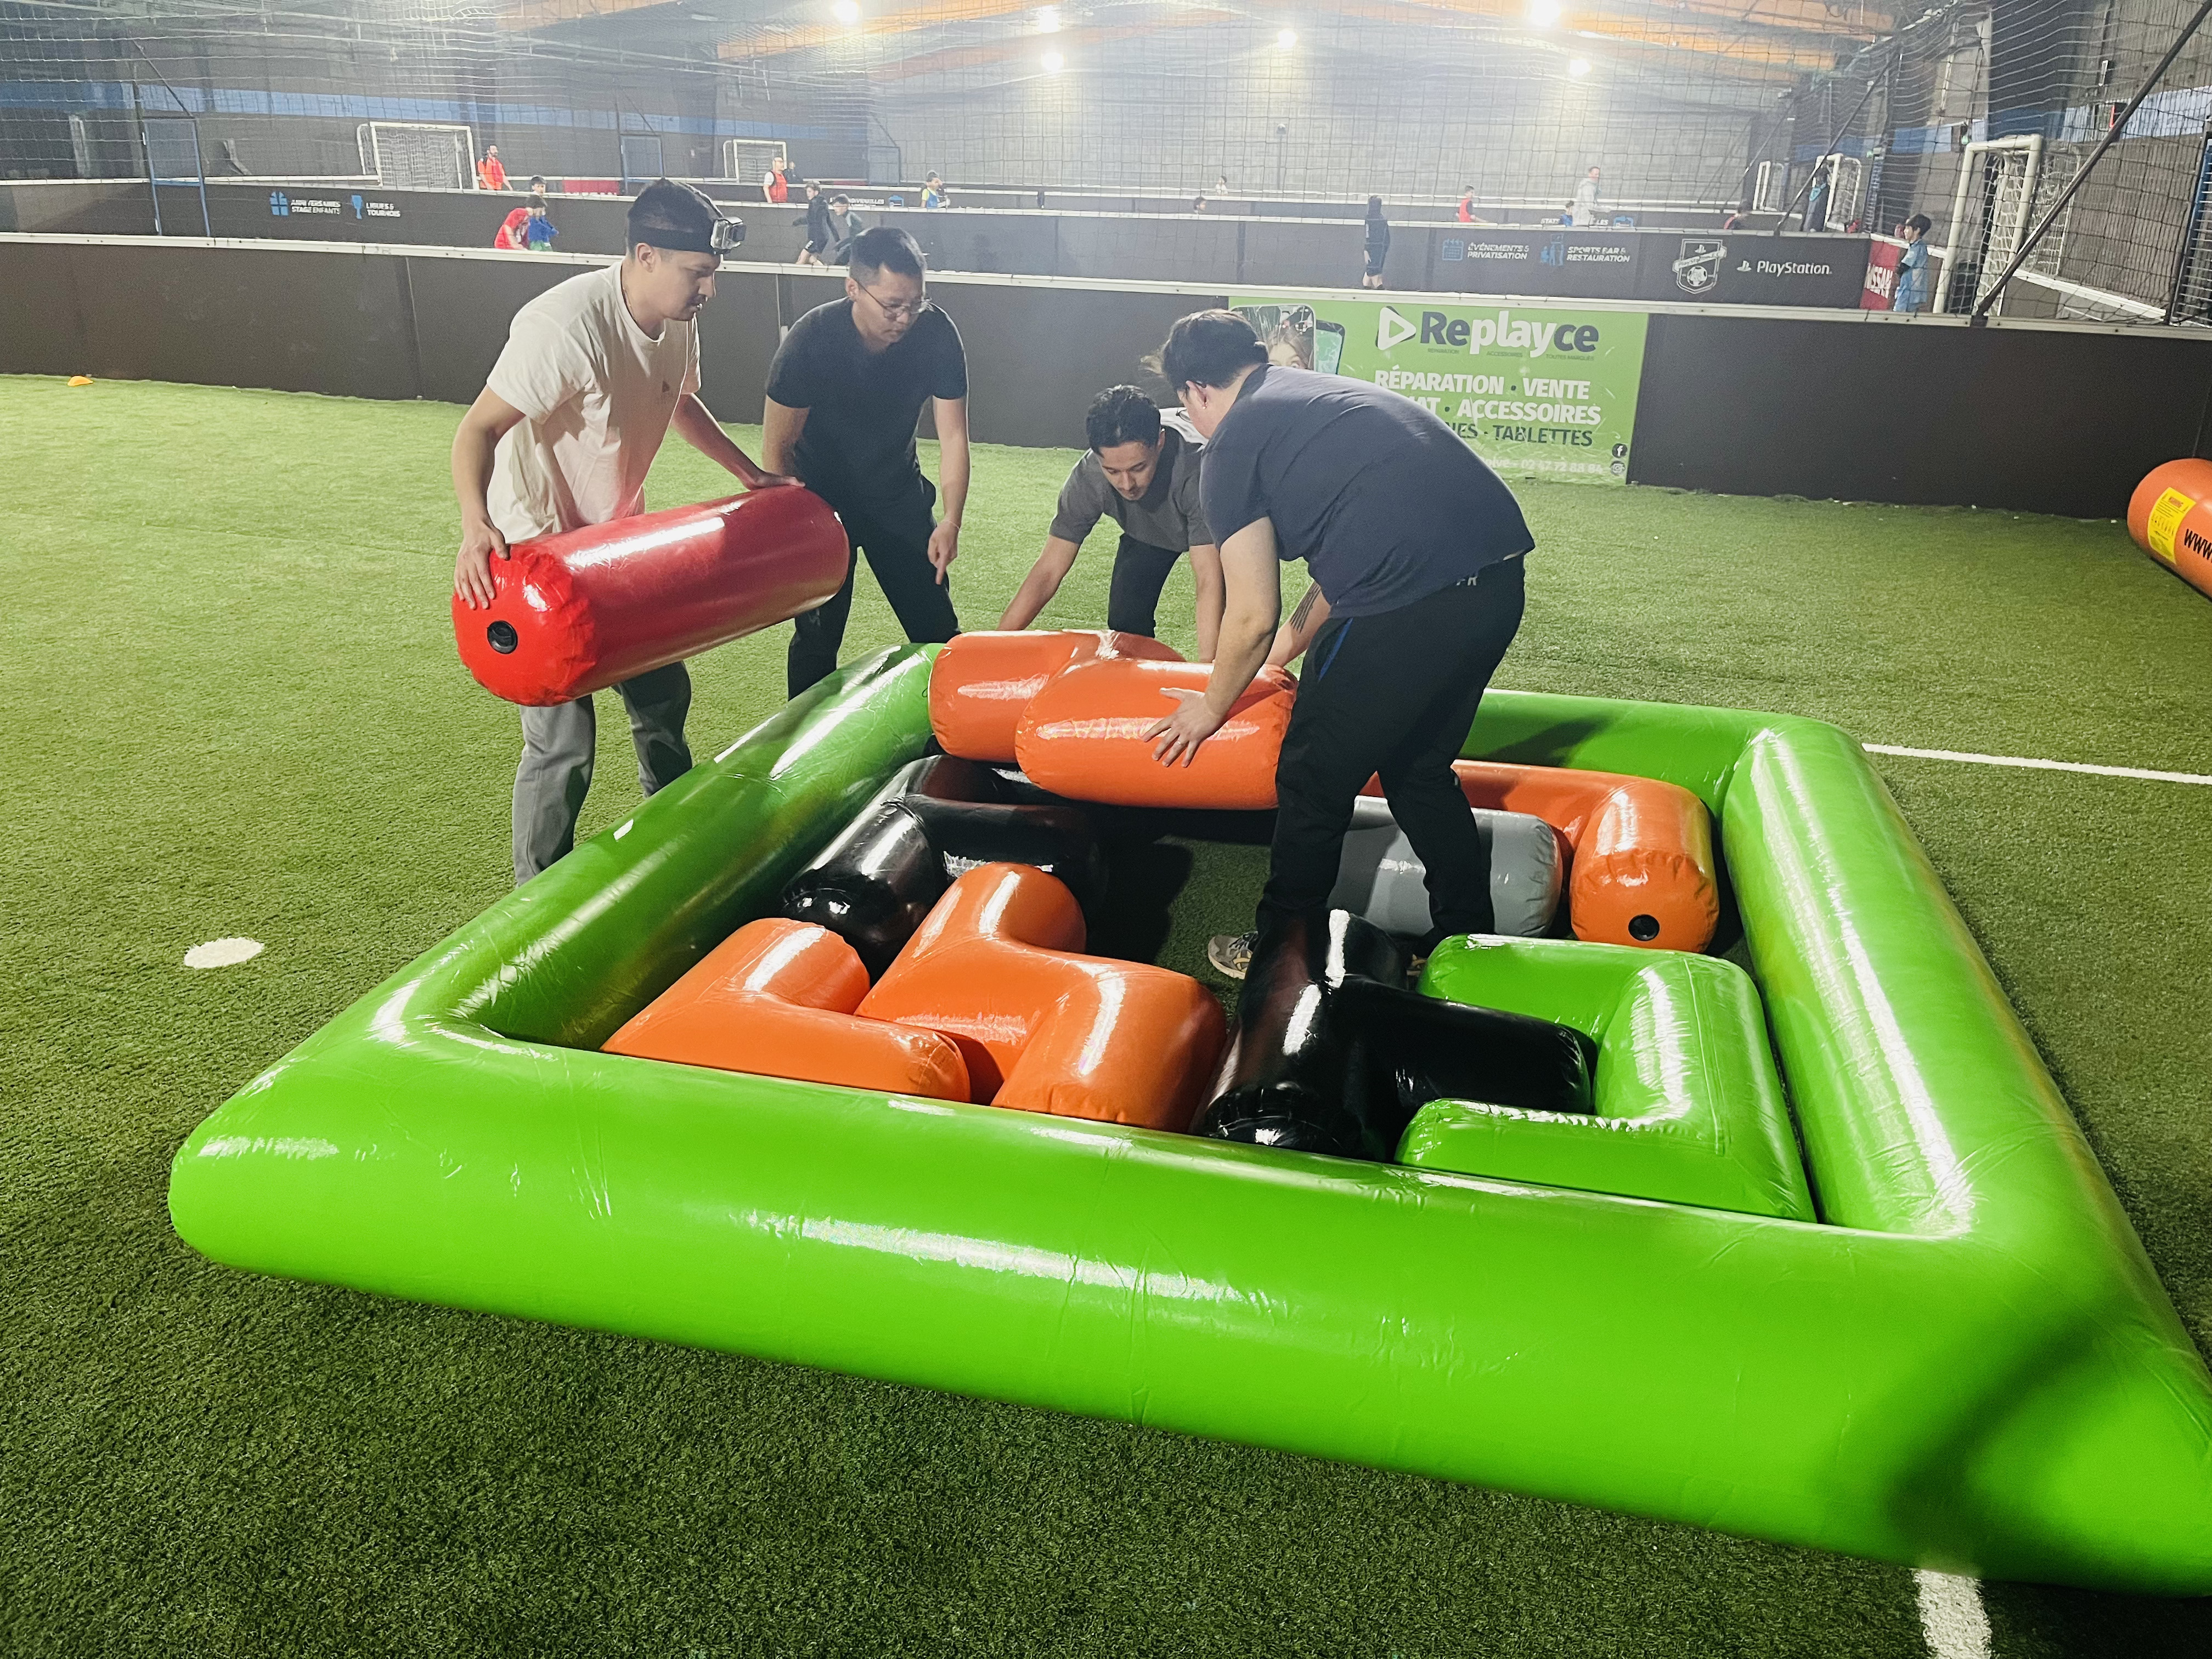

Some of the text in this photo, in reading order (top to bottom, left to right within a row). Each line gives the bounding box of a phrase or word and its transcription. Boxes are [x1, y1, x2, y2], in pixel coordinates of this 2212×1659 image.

[1468, 251, 1527, 259] PRIVATISATION
[1567, 254, 1630, 262] RESTAURATION
[1757, 261, 1830, 276] PlayStation
[1420, 311, 1599, 358] Replayce
[1375, 364, 1590, 399] RÉPARATION VENTE
[1457, 399, 1601, 425] ACCESSOIRES
[1493, 425, 1593, 447] TABLETTES
